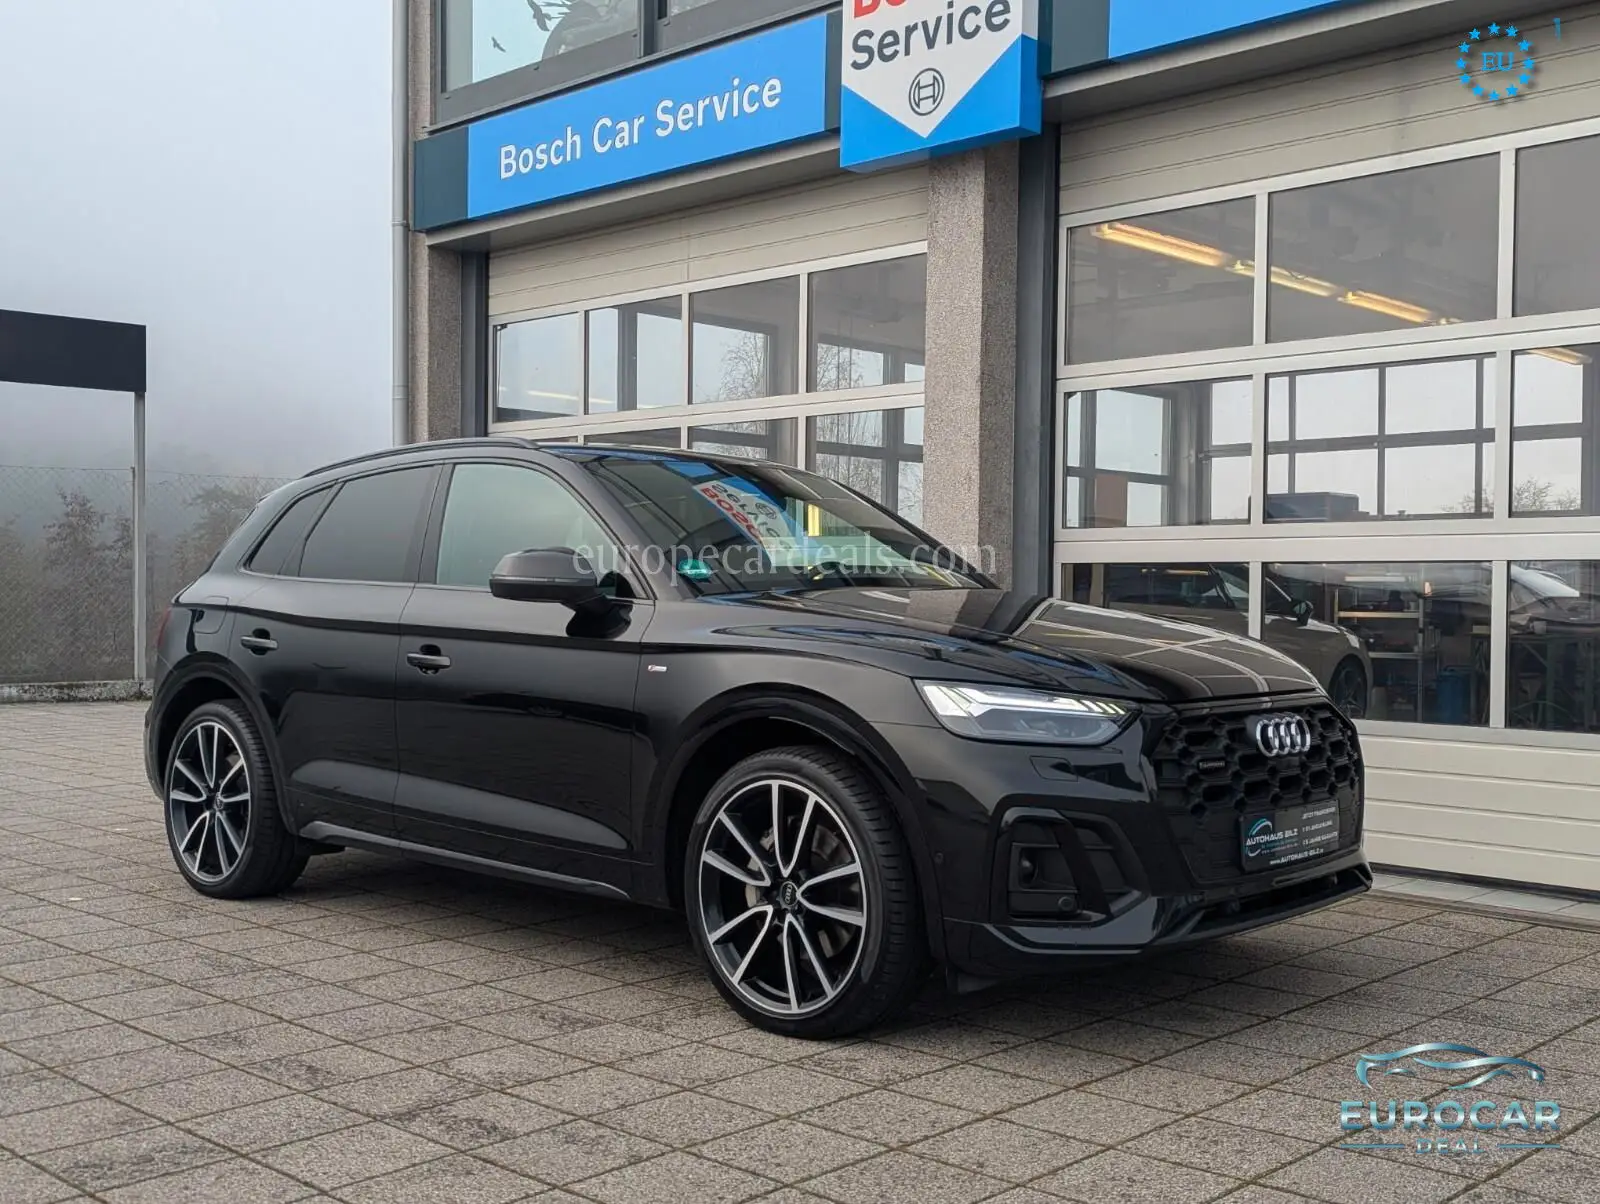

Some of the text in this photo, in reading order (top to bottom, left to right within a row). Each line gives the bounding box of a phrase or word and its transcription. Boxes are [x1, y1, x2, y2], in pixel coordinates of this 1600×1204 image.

[850, 0, 1011, 70] Service
[500, 77, 783, 180] Bosch Car Service
[1246, 831, 1283, 846] AUTOHAUS
